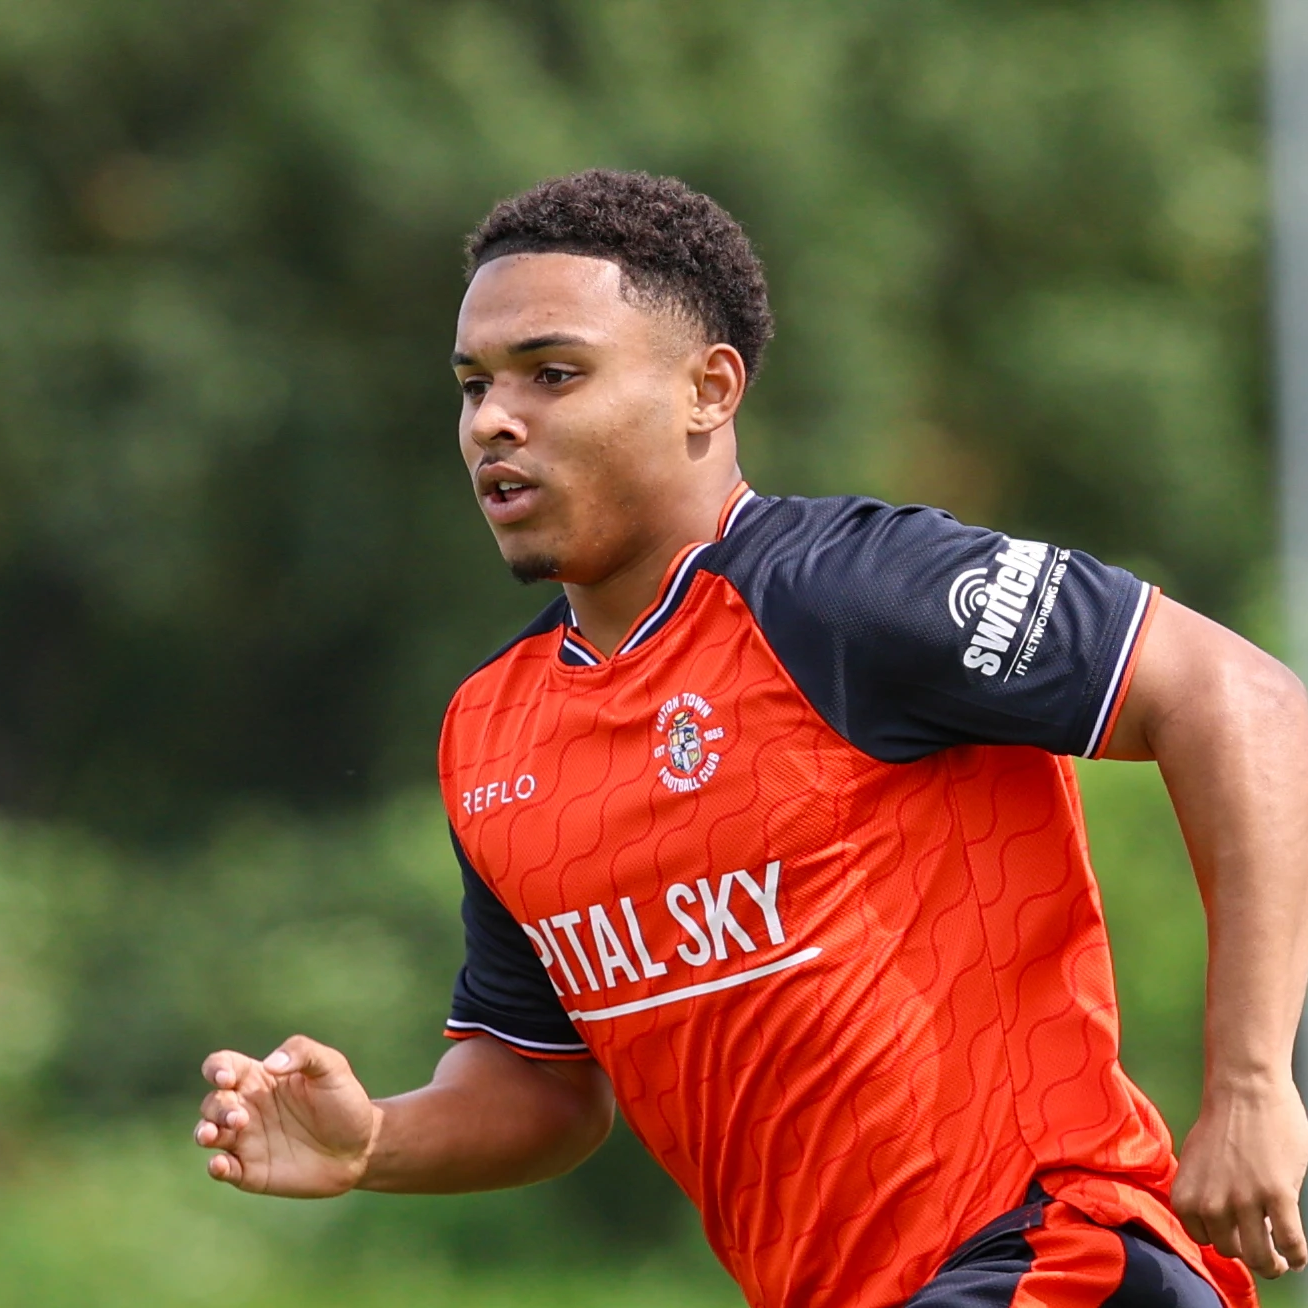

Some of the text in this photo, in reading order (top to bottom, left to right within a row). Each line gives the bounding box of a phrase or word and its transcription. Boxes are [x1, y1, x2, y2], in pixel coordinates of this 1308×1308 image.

[1014, 660, 1028, 677] IT
[1050, 562, 1068, 585] AND
[655, 692, 713, 733] LUTON TOWN
[653, 744, 666, 759] EST
[657, 751, 721, 794] FOOTBALL CLUB
[462, 773, 536, 816] REFLO
[665, 859, 786, 967] SKY
